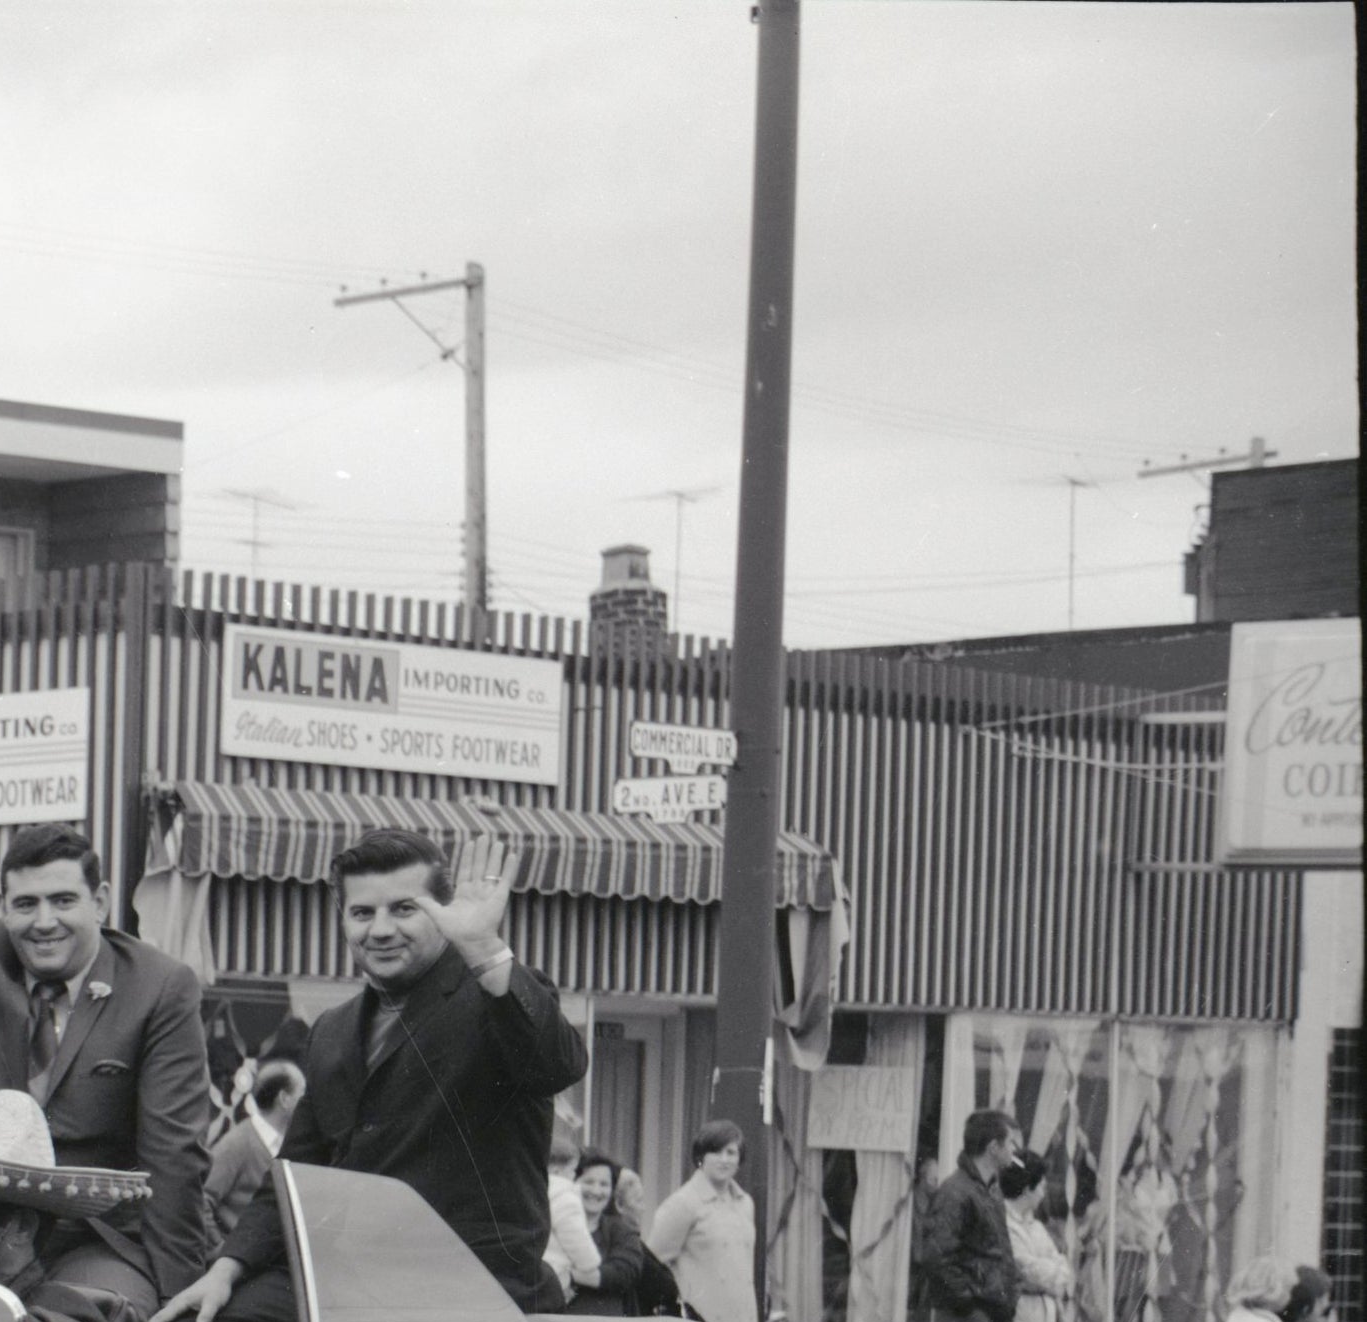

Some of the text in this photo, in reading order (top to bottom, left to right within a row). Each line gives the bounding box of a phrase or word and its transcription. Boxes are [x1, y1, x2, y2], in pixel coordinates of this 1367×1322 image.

[241, 641, 389, 704] KALENA
[404, 667, 520, 699] IMPORTING
[233, 710, 541, 768] Italian SHOES SPORTS FOOTWEAR
[633, 727, 711, 758] COMMERCIAL
[707, 781, 717, 804] E
